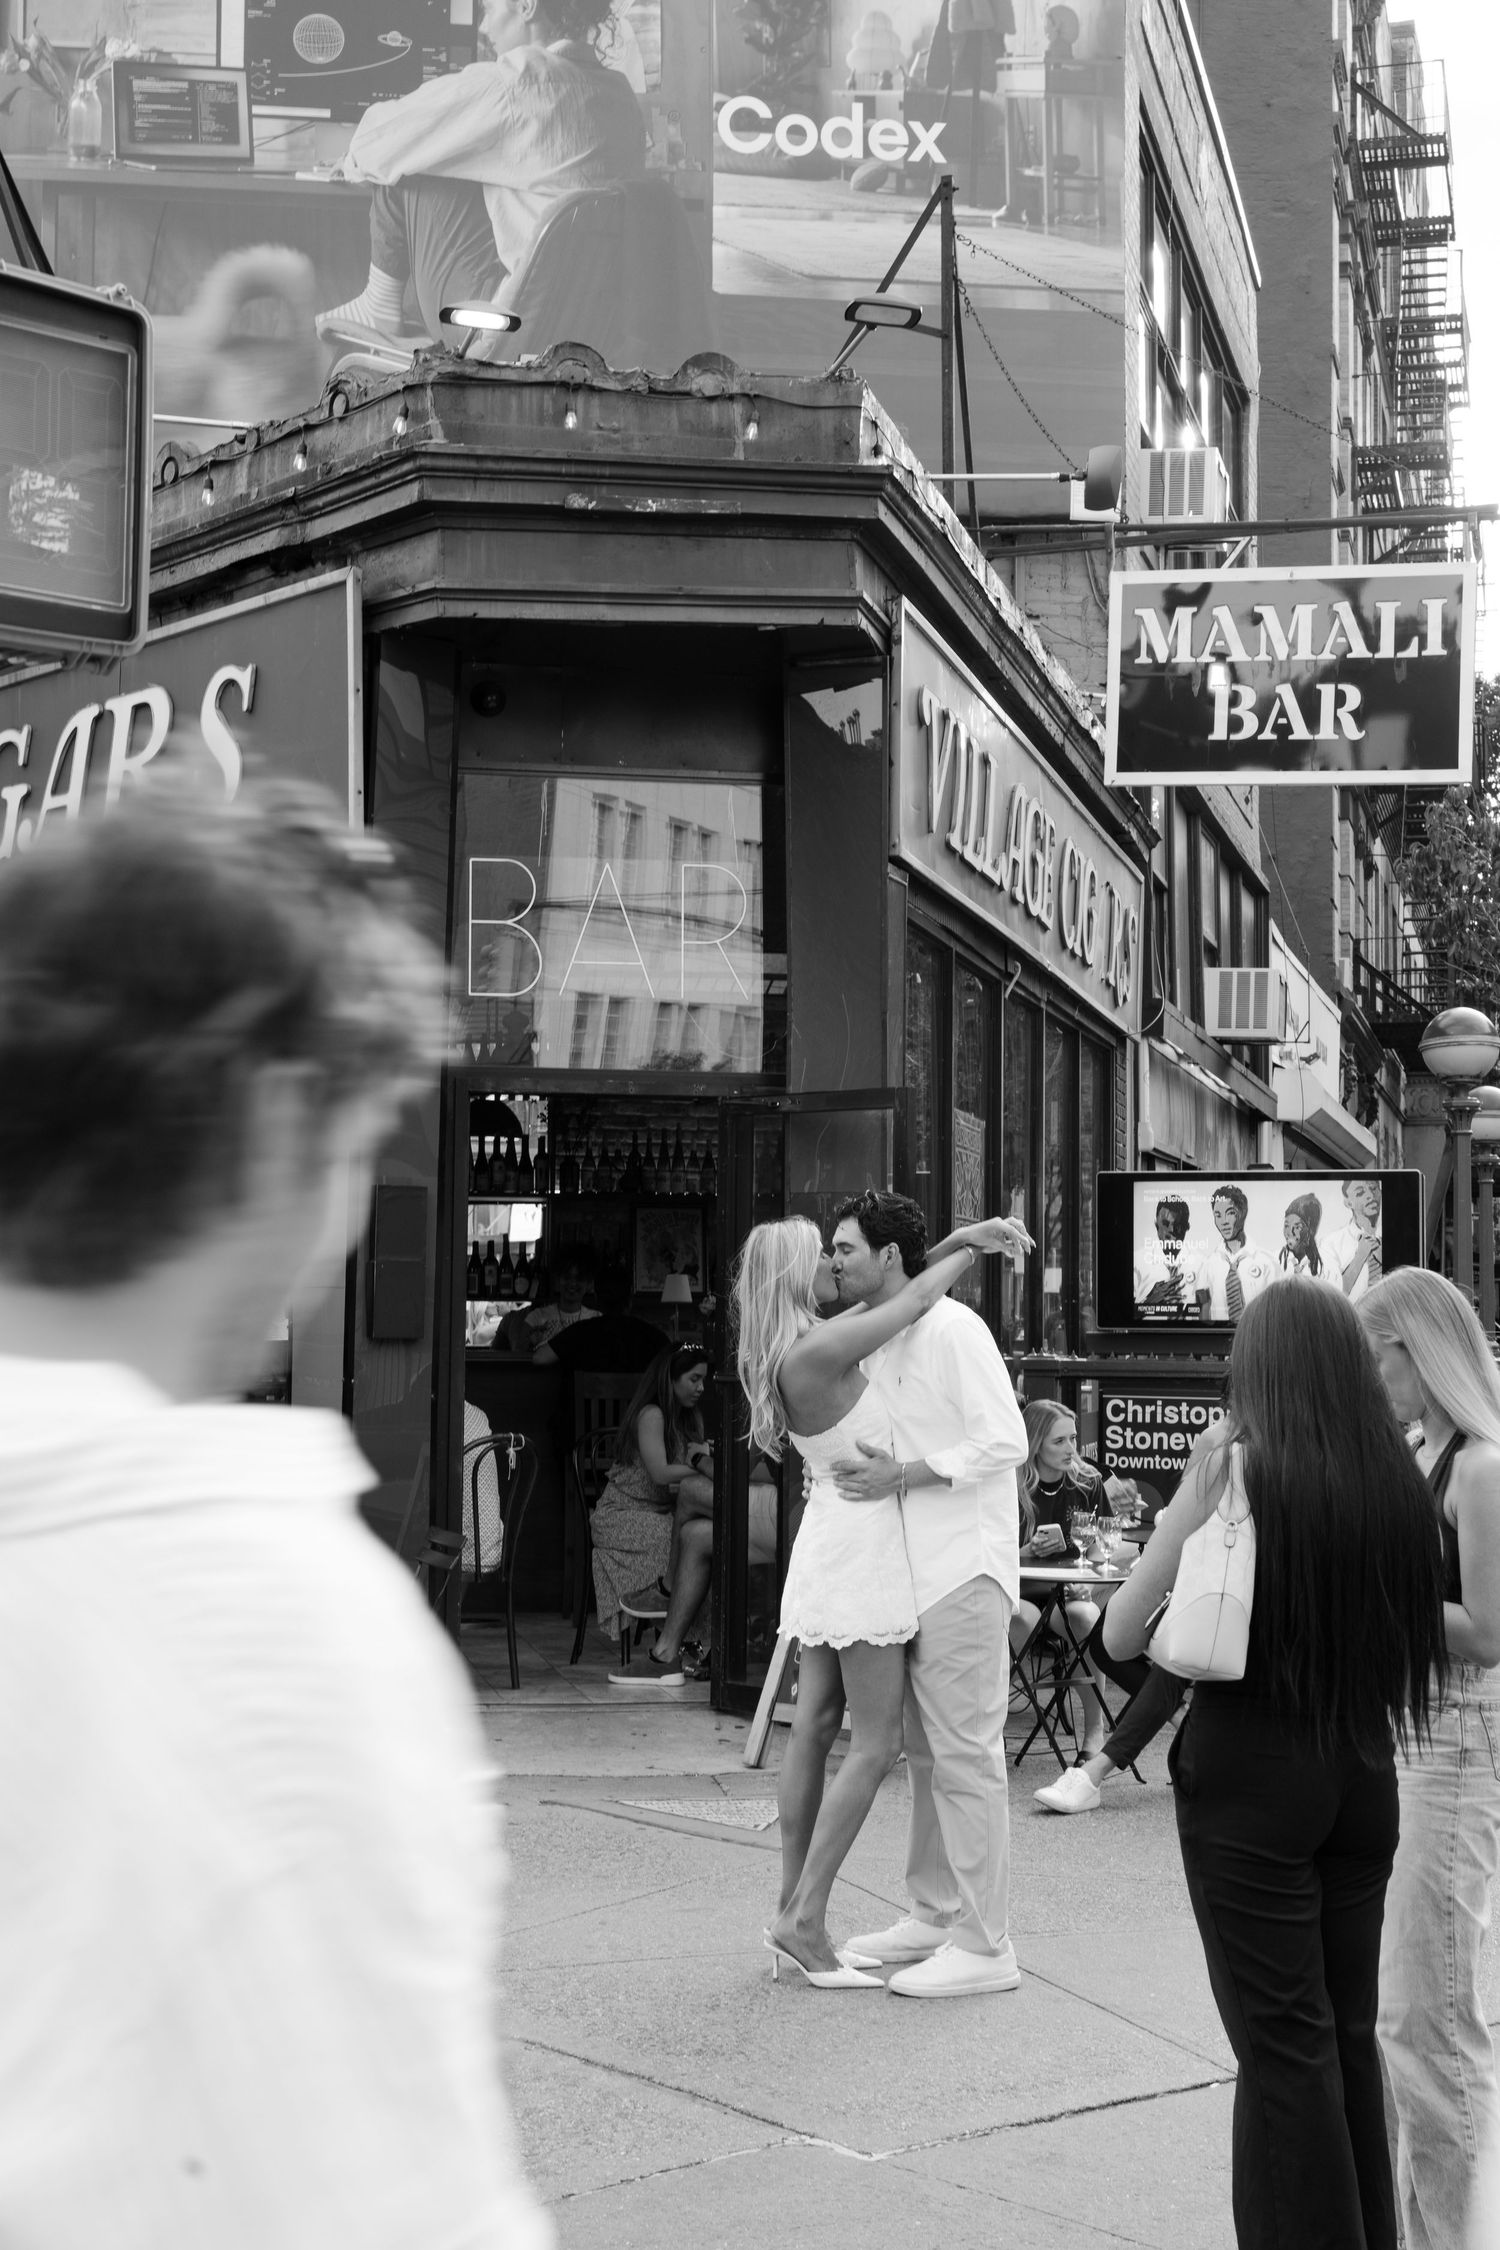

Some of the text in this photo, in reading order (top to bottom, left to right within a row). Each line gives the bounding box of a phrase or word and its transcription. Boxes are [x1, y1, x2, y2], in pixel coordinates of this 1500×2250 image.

[717, 95, 948, 165] Codex
[1134, 598, 1448, 664] MAMALI
[1207, 682, 1366, 741] BAR
[918, 683, 1056, 931] VILLAGE
[468, 857, 749, 1000] BAR
[1105, 1399, 1231, 1425] Christop
[1105, 1453, 1190, 1470] Downtow
